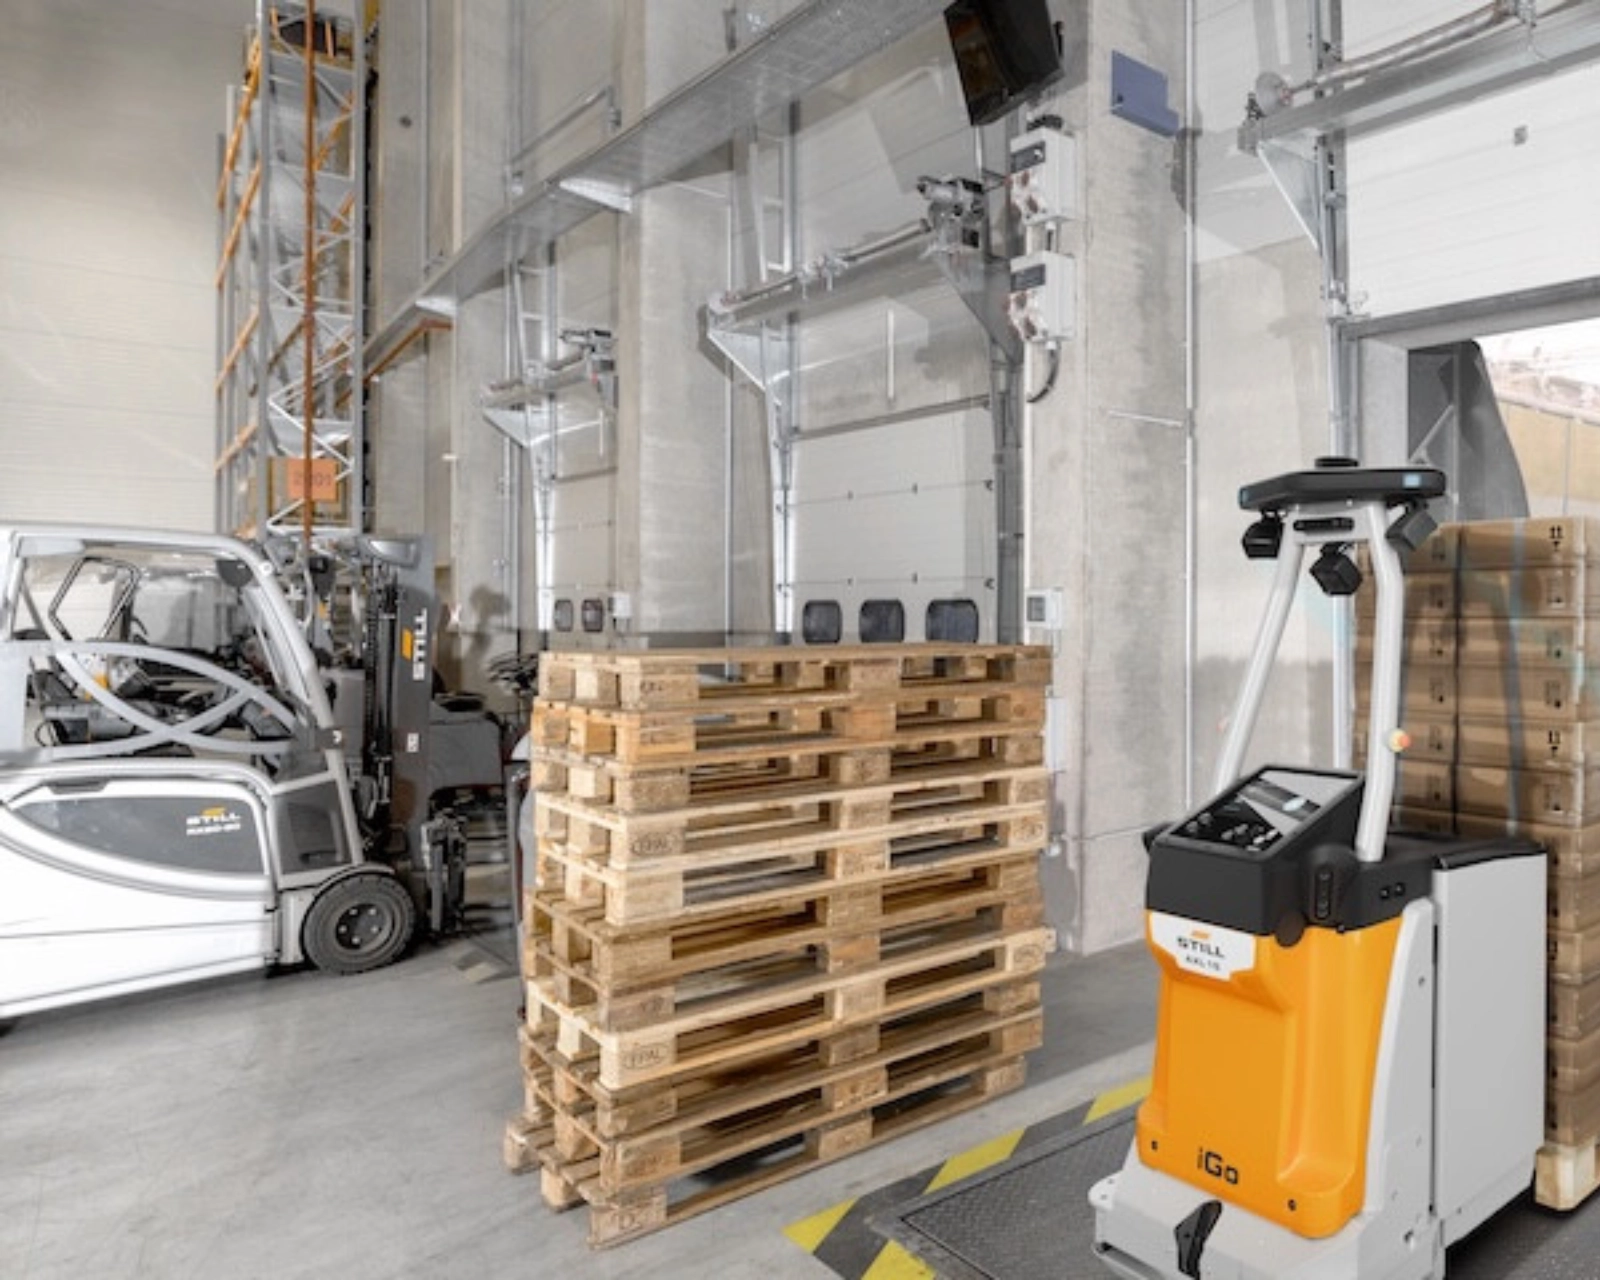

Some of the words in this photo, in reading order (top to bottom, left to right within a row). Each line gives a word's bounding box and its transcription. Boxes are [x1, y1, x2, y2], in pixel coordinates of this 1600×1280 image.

[412, 607, 428, 682] STILL
[186, 812, 241, 825] STILL
[1177, 936, 1225, 959] STILL
[1196, 1146, 1239, 1185] iGo
